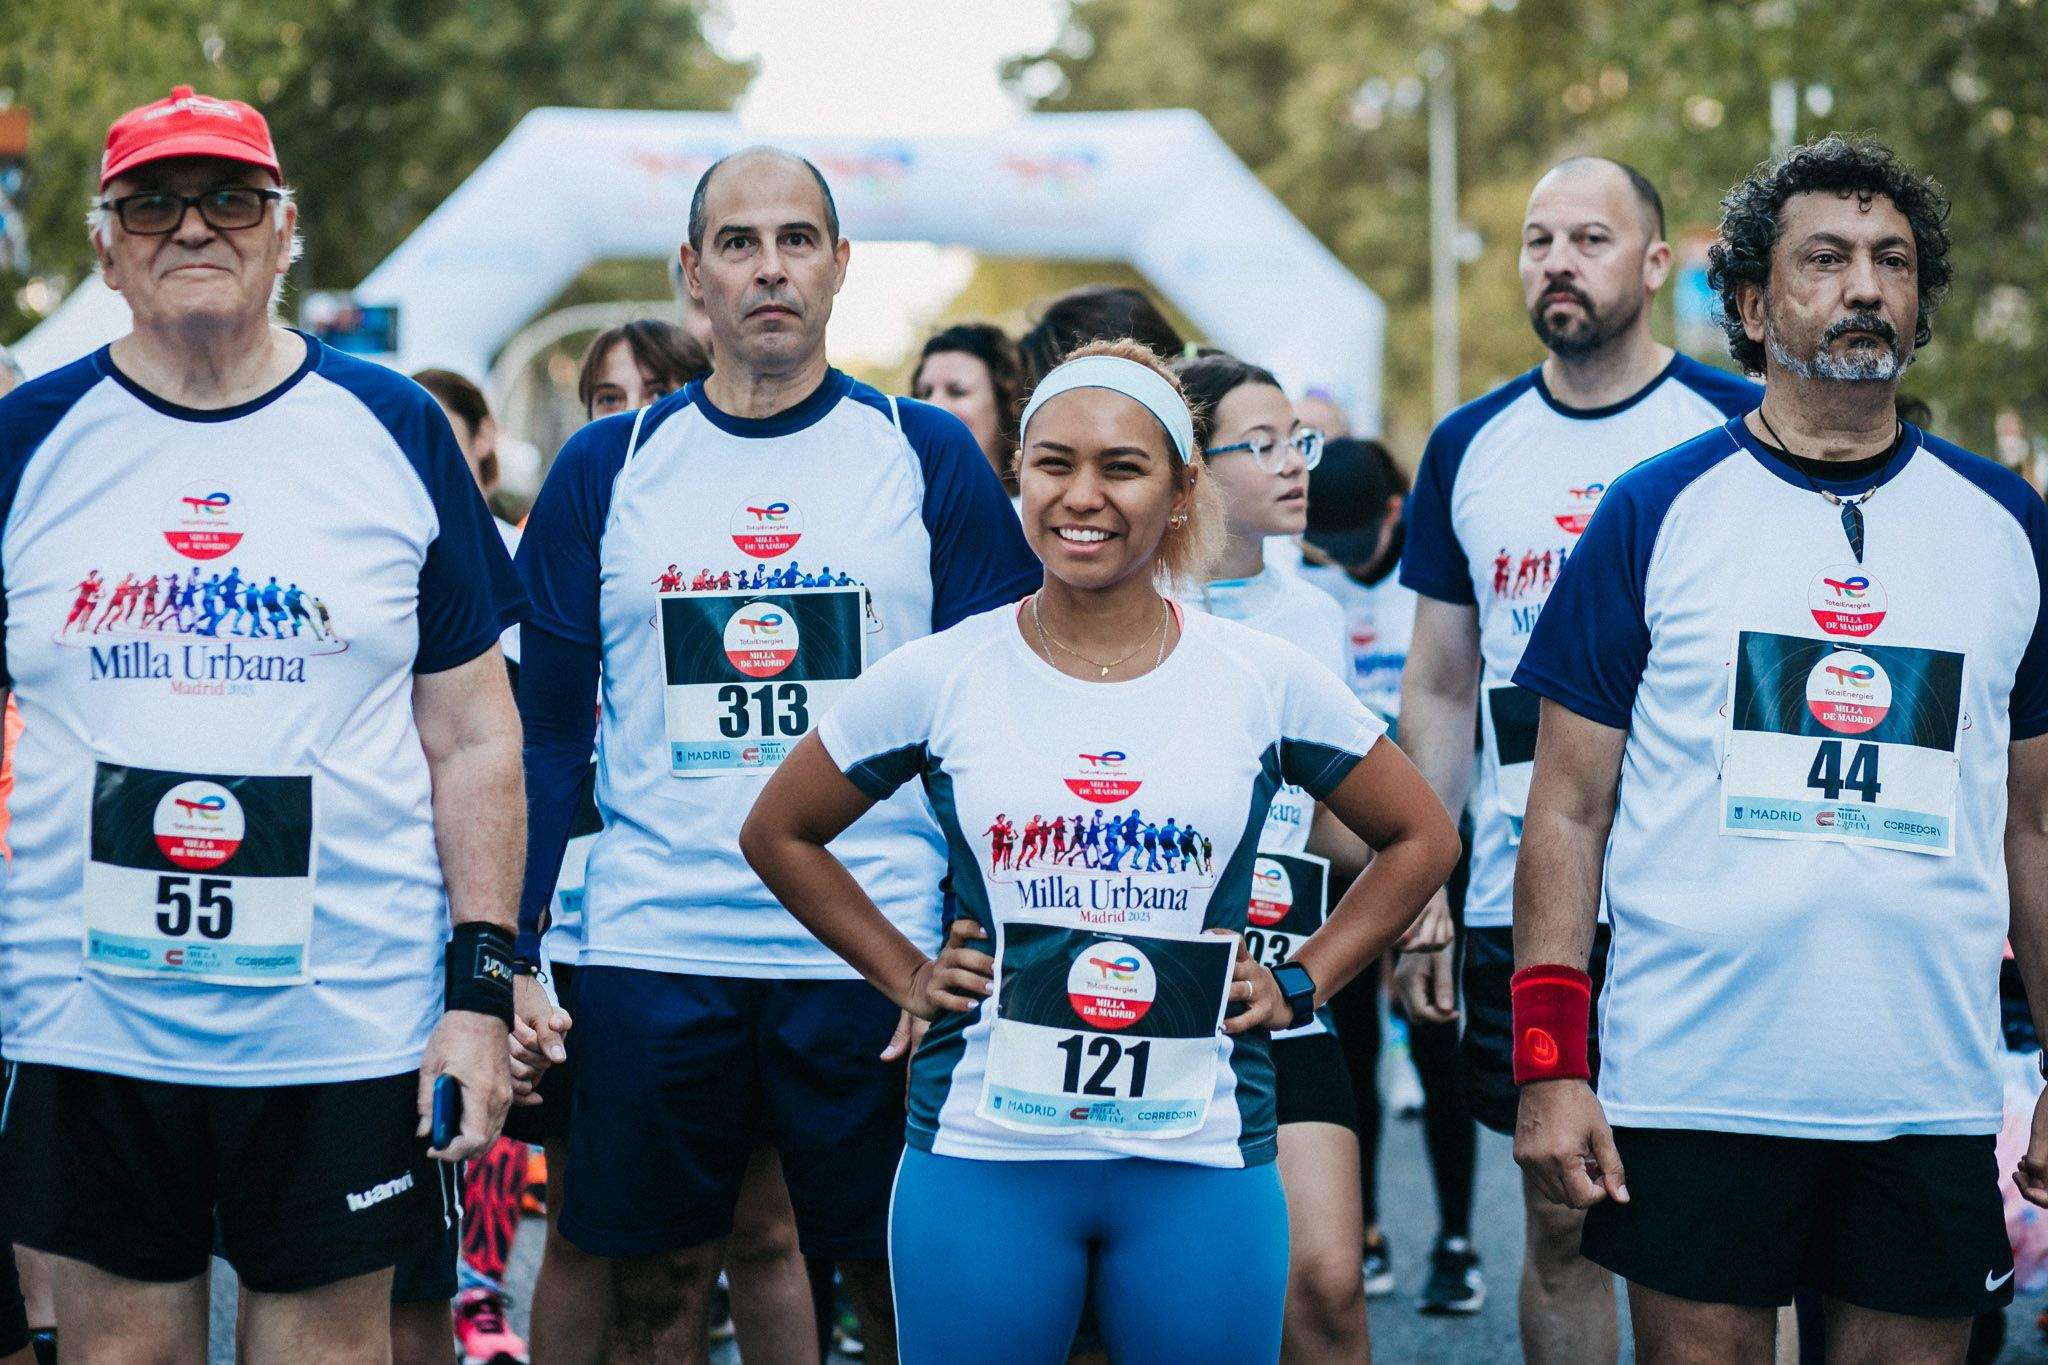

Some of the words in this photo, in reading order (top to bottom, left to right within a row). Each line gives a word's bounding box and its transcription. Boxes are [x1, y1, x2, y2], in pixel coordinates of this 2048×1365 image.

[1825, 600, 1871, 609] TotalEnergies
[1836, 614, 1863, 624] MILLA
[1840, 623, 1873, 632] MADRID
[750, 651, 776, 659] MILLA
[89, 641, 172, 681] Milla
[183, 643, 306, 683] Urbana
[741, 660, 752, 668] DE
[170, 681, 225, 696] Madrid
[1824, 689, 1874, 700] TotalEnergies
[718, 683, 810, 739] 313
[1834, 704, 1864, 715] MILLA
[1838, 713, 1874, 725] MADRID
[687, 750, 731, 761] MADRID
[1807, 740, 1882, 804] 44
[1089, 780, 1119, 788] MILLA
[1079, 788, 1092, 796] DE
[1094, 788, 1129, 796] MADRID
[1750, 808, 1802, 822] MADRID
[1836, 812, 1867, 822] MILLA
[1015, 875, 1082, 910] Milla
[1089, 875, 1188, 911] Urbana
[157, 876, 233, 940] 55
[1080, 910, 1125, 924] Madrid
[1095, 998, 1125, 1009] MILLA
[1083, 1005, 1097, 1016] DE
[1098, 1007, 1136, 1019] MADRID
[1057, 1034, 1151, 1098] 121
[1007, 1100, 1057, 1117] MADRID
